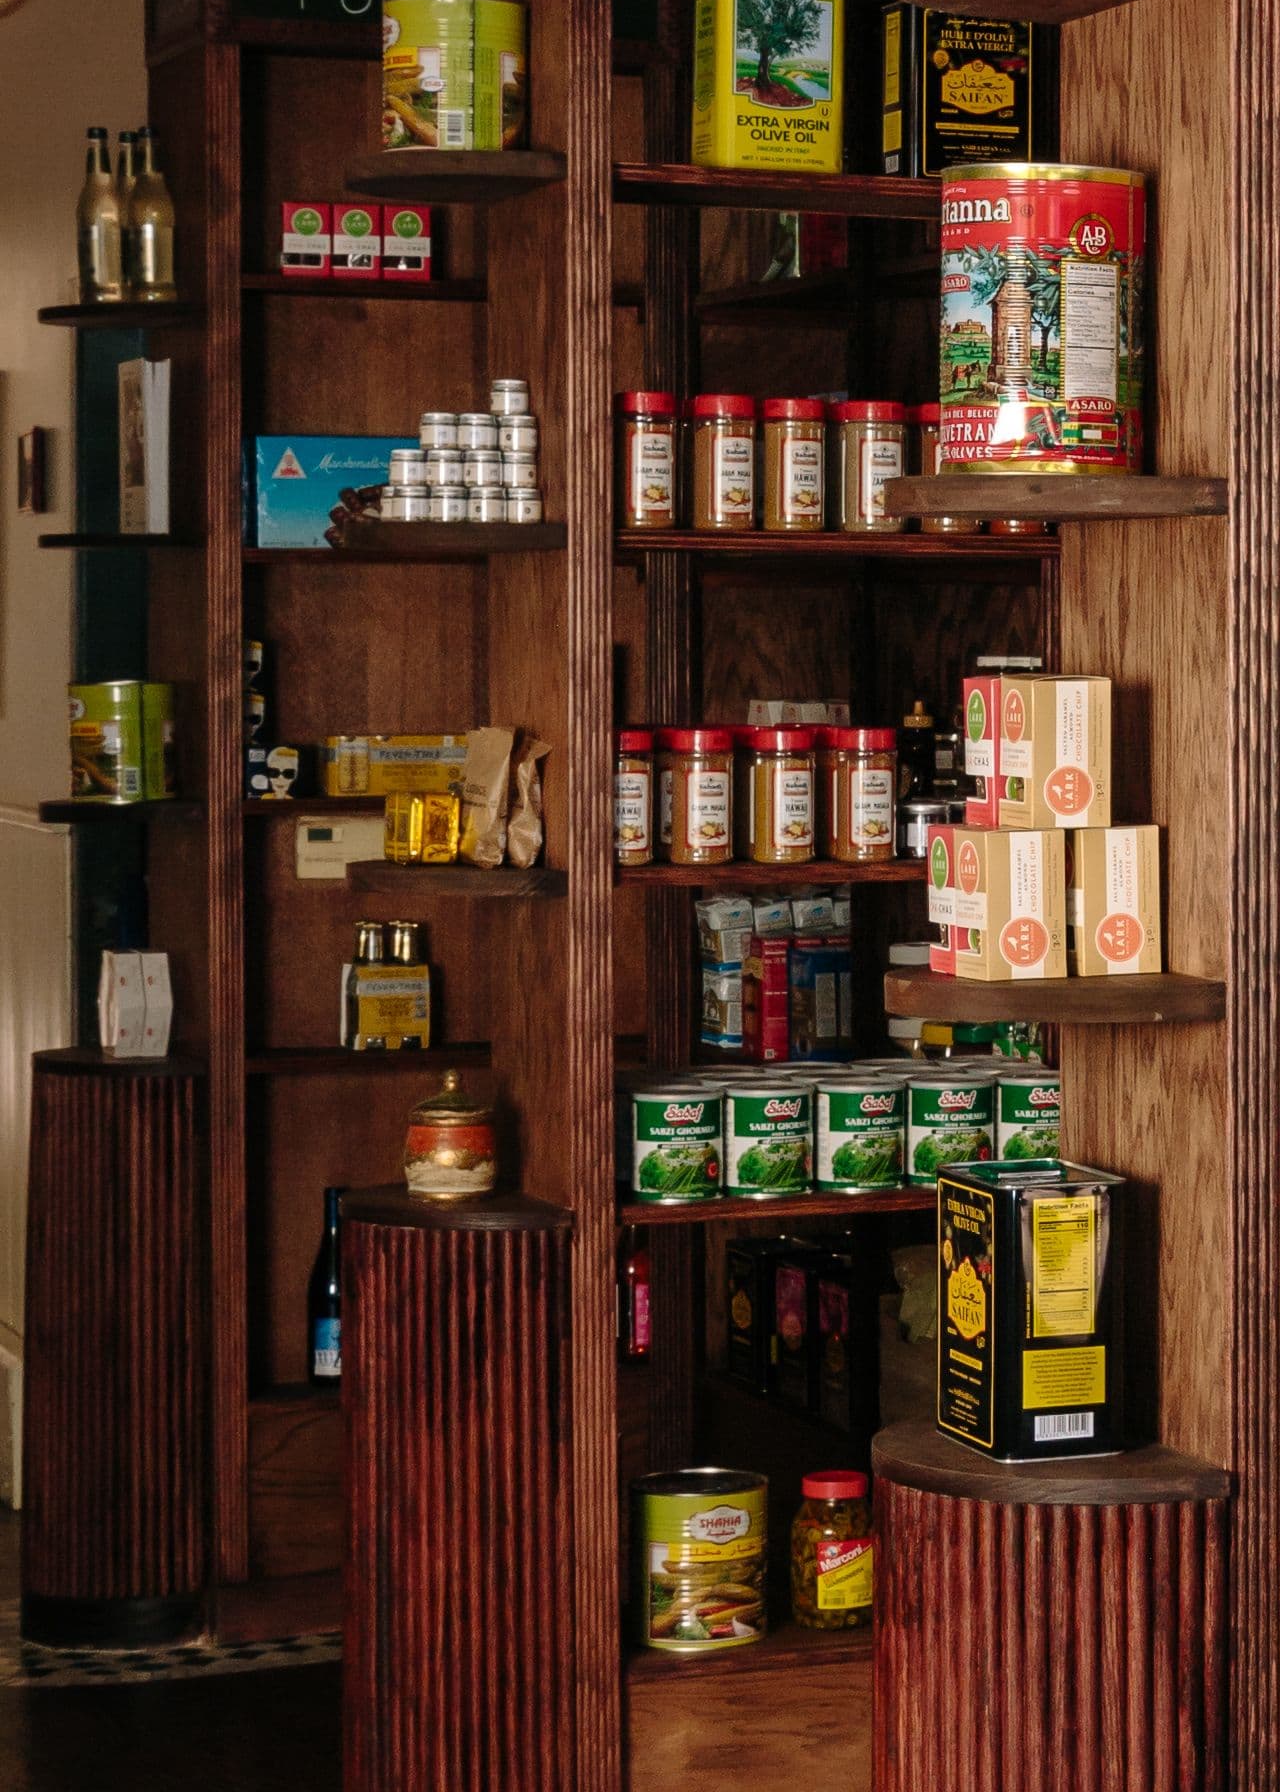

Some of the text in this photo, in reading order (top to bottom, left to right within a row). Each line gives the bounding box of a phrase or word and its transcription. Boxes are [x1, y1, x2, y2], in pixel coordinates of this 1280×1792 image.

[949, 91, 1002, 105] SAIFAN
[736, 114, 830, 132] EXTRA VIRGIN
[750, 128, 817, 144] OLIVE OIL
[1070, 399, 1112, 411] ASARO
[1065, 771, 1075, 809] LARK
[1020, 922, 1030, 961] LARK
[1116, 918, 1126, 956] LARK
[700, 1513, 742, 1529] SHAHIA
[819, 1545, 863, 1572] Marconi
